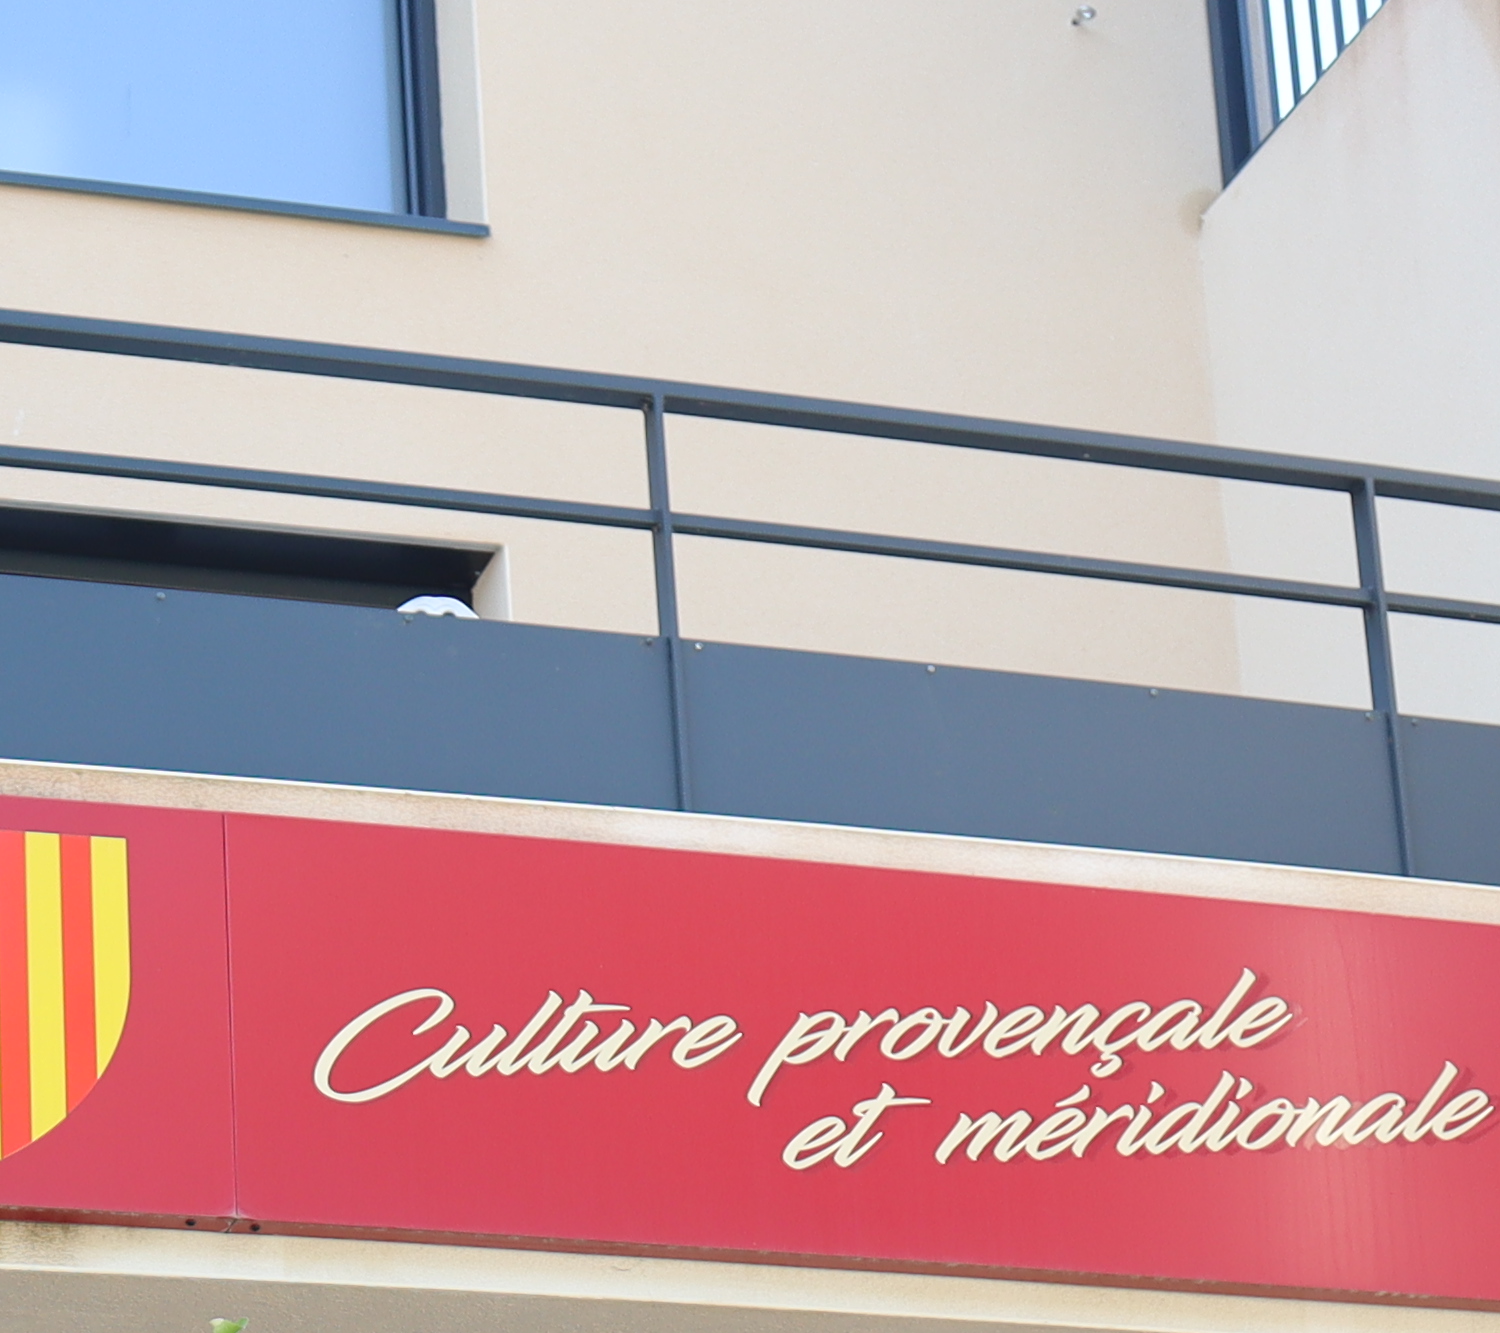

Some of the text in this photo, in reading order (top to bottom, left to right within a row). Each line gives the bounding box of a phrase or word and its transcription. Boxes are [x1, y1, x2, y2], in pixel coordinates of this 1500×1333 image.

[312, 967, 1294, 1109] Culture provençale
[782, 1061, 1495, 1171] et méridionale
